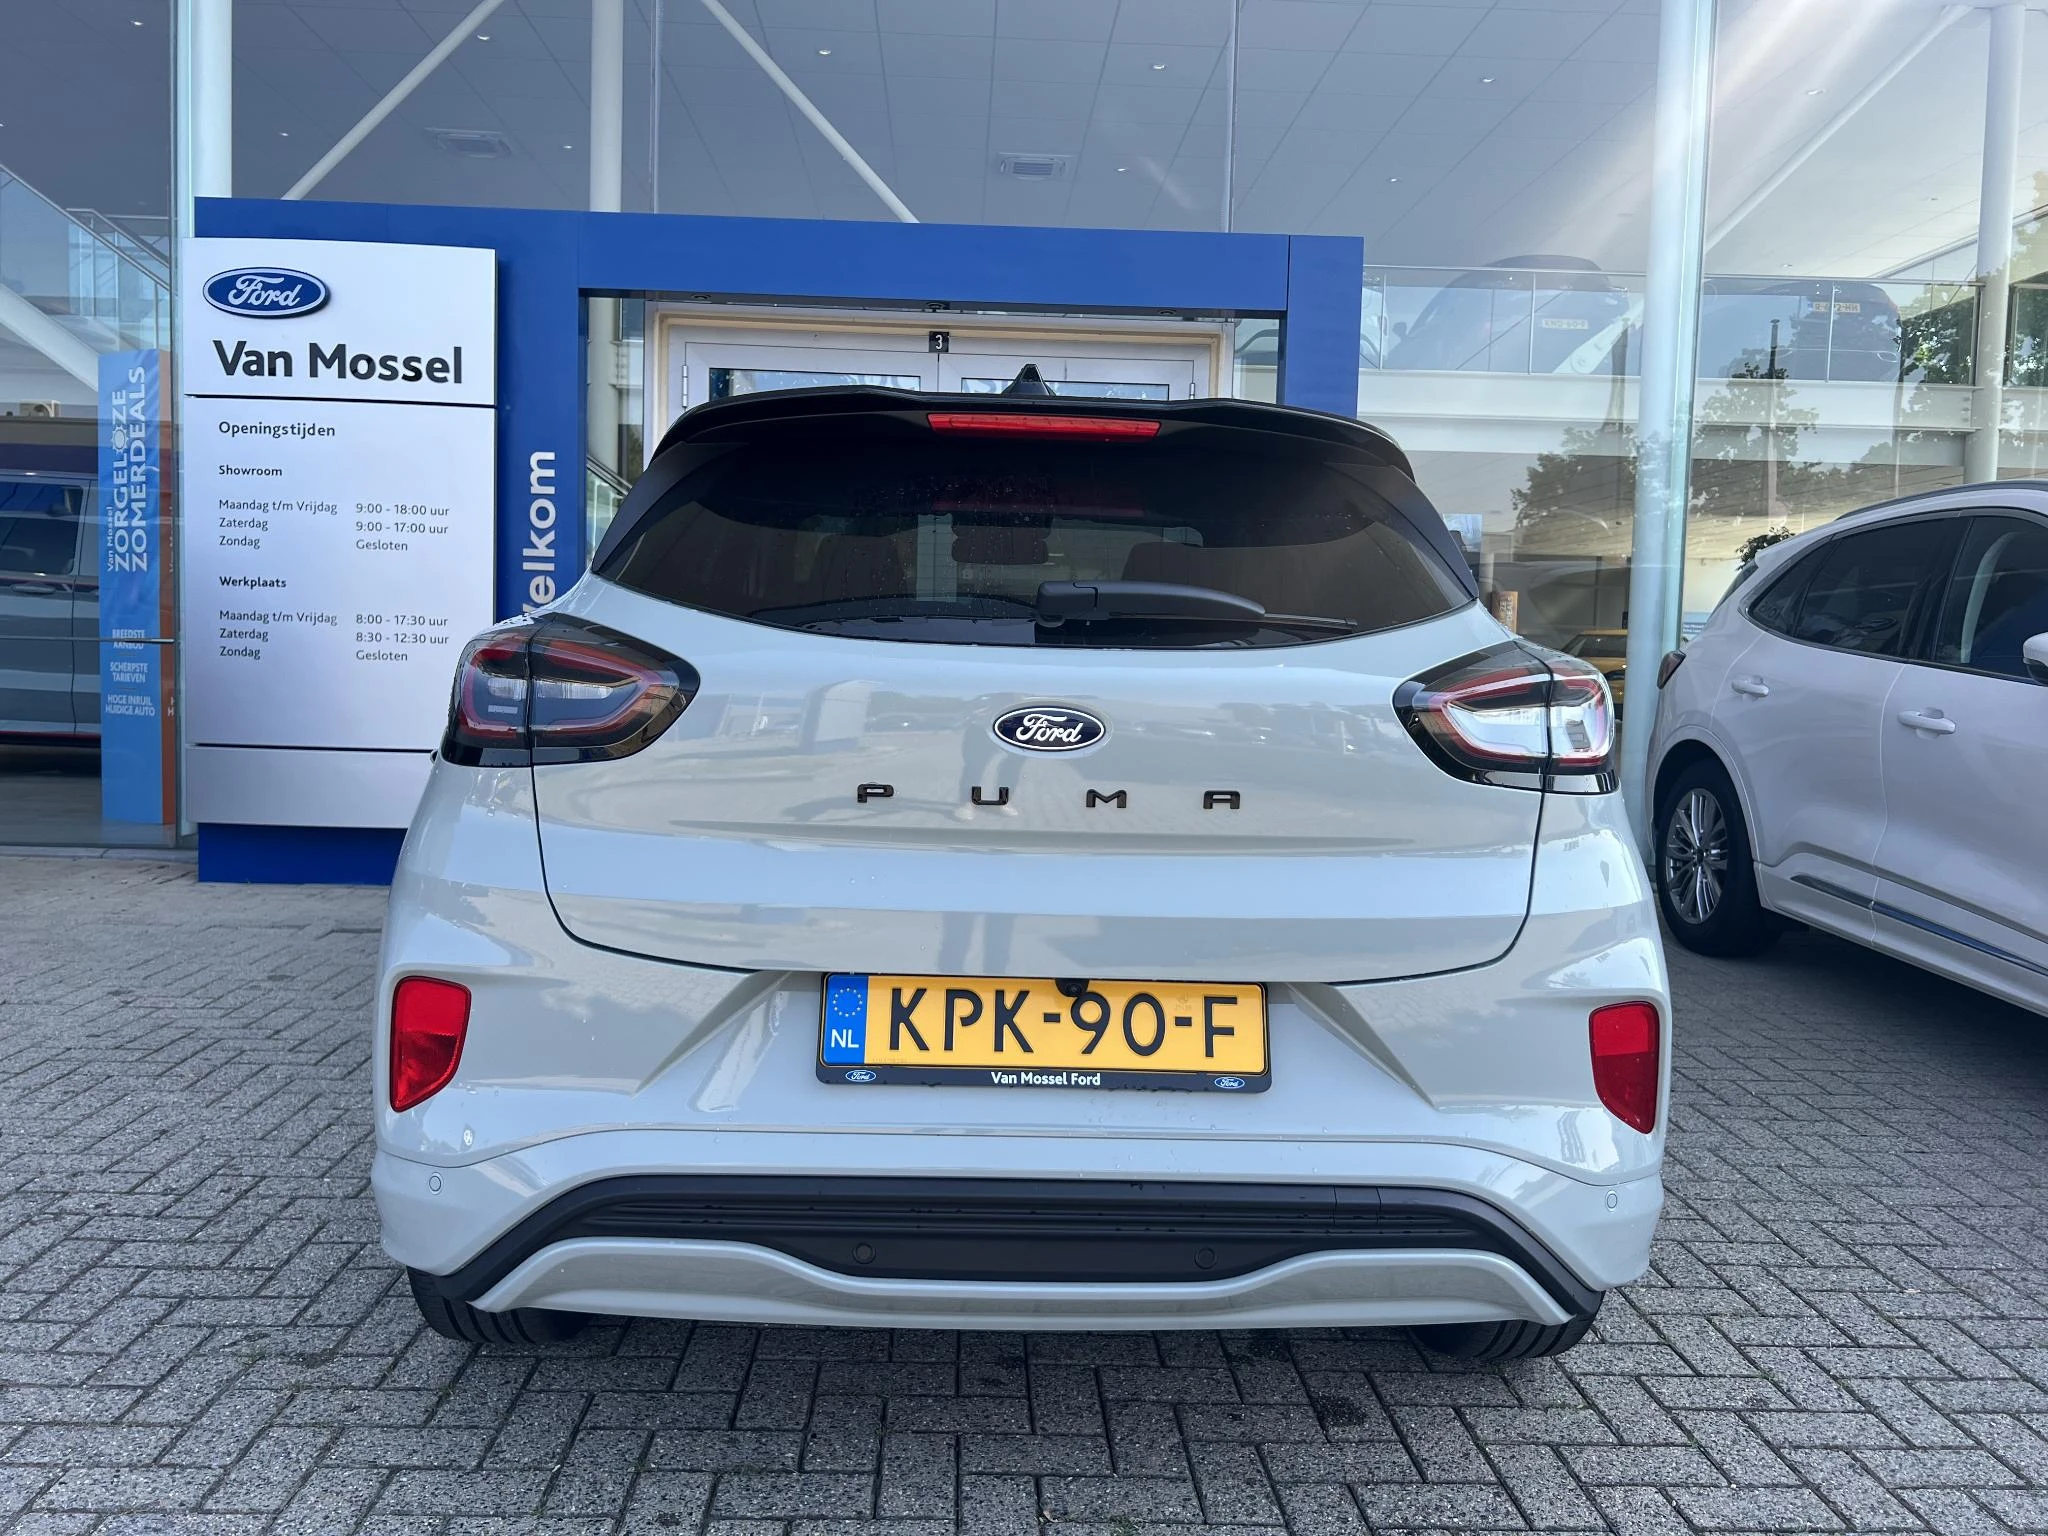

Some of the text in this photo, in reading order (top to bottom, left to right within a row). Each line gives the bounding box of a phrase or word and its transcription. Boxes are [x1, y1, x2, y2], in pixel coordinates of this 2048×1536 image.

[228, 275, 302, 306] Ford
[935, 334, 943, 350] 3
[212, 340, 462, 384] Van Mossel
[219, 421, 336, 439] Openingstijden
[129, 366, 148, 573] ZOMERDEALS
[218, 465, 283, 477] Showroom
[219, 499, 269, 513] Maandag
[272, 501, 293, 511] t/m
[297, 501, 338, 515] Vrijdag
[355, 503, 383, 514] 9:00
[394, 504, 427, 516] 18:00
[430, 507, 450, 516] uur
[219, 518, 269, 531] Zaterdag
[355, 521, 383, 532] 9:00
[394, 522, 426, 534] 17:00
[428, 525, 449, 534] uur
[522, 451, 556, 614] elkom
[219, 536, 408, 551] Zondag Gesloten
[106, 551, 114, 572] Van
[219, 576, 287, 590] Werkplaats
[219, 610, 270, 624] Maandag
[272, 611, 293, 622] t/m
[297, 612, 338, 626] Vrijdag
[355, 614, 383, 625] 8:00
[394, 615, 426, 626] 17:30
[428, 618, 449, 627] uur
[219, 628, 269, 642] Zaterdag
[355, 632, 382, 643] 8:30
[394, 632, 426, 644] 12:30
[429, 636, 450, 645] uur
[219, 646, 408, 661] Zondag Gesloten
[110, 662, 148, 673] SCHERPSTE
[112, 672, 146, 683] TARIEVEN
[134, 706, 156, 716] AUTO
[1016, 713, 1084, 744] Ford
[889, 987, 1238, 1058] KPK-90-F
[831, 1029, 860, 1049] NL
[991, 1071, 1101, 1086] Van Mossel Ford
